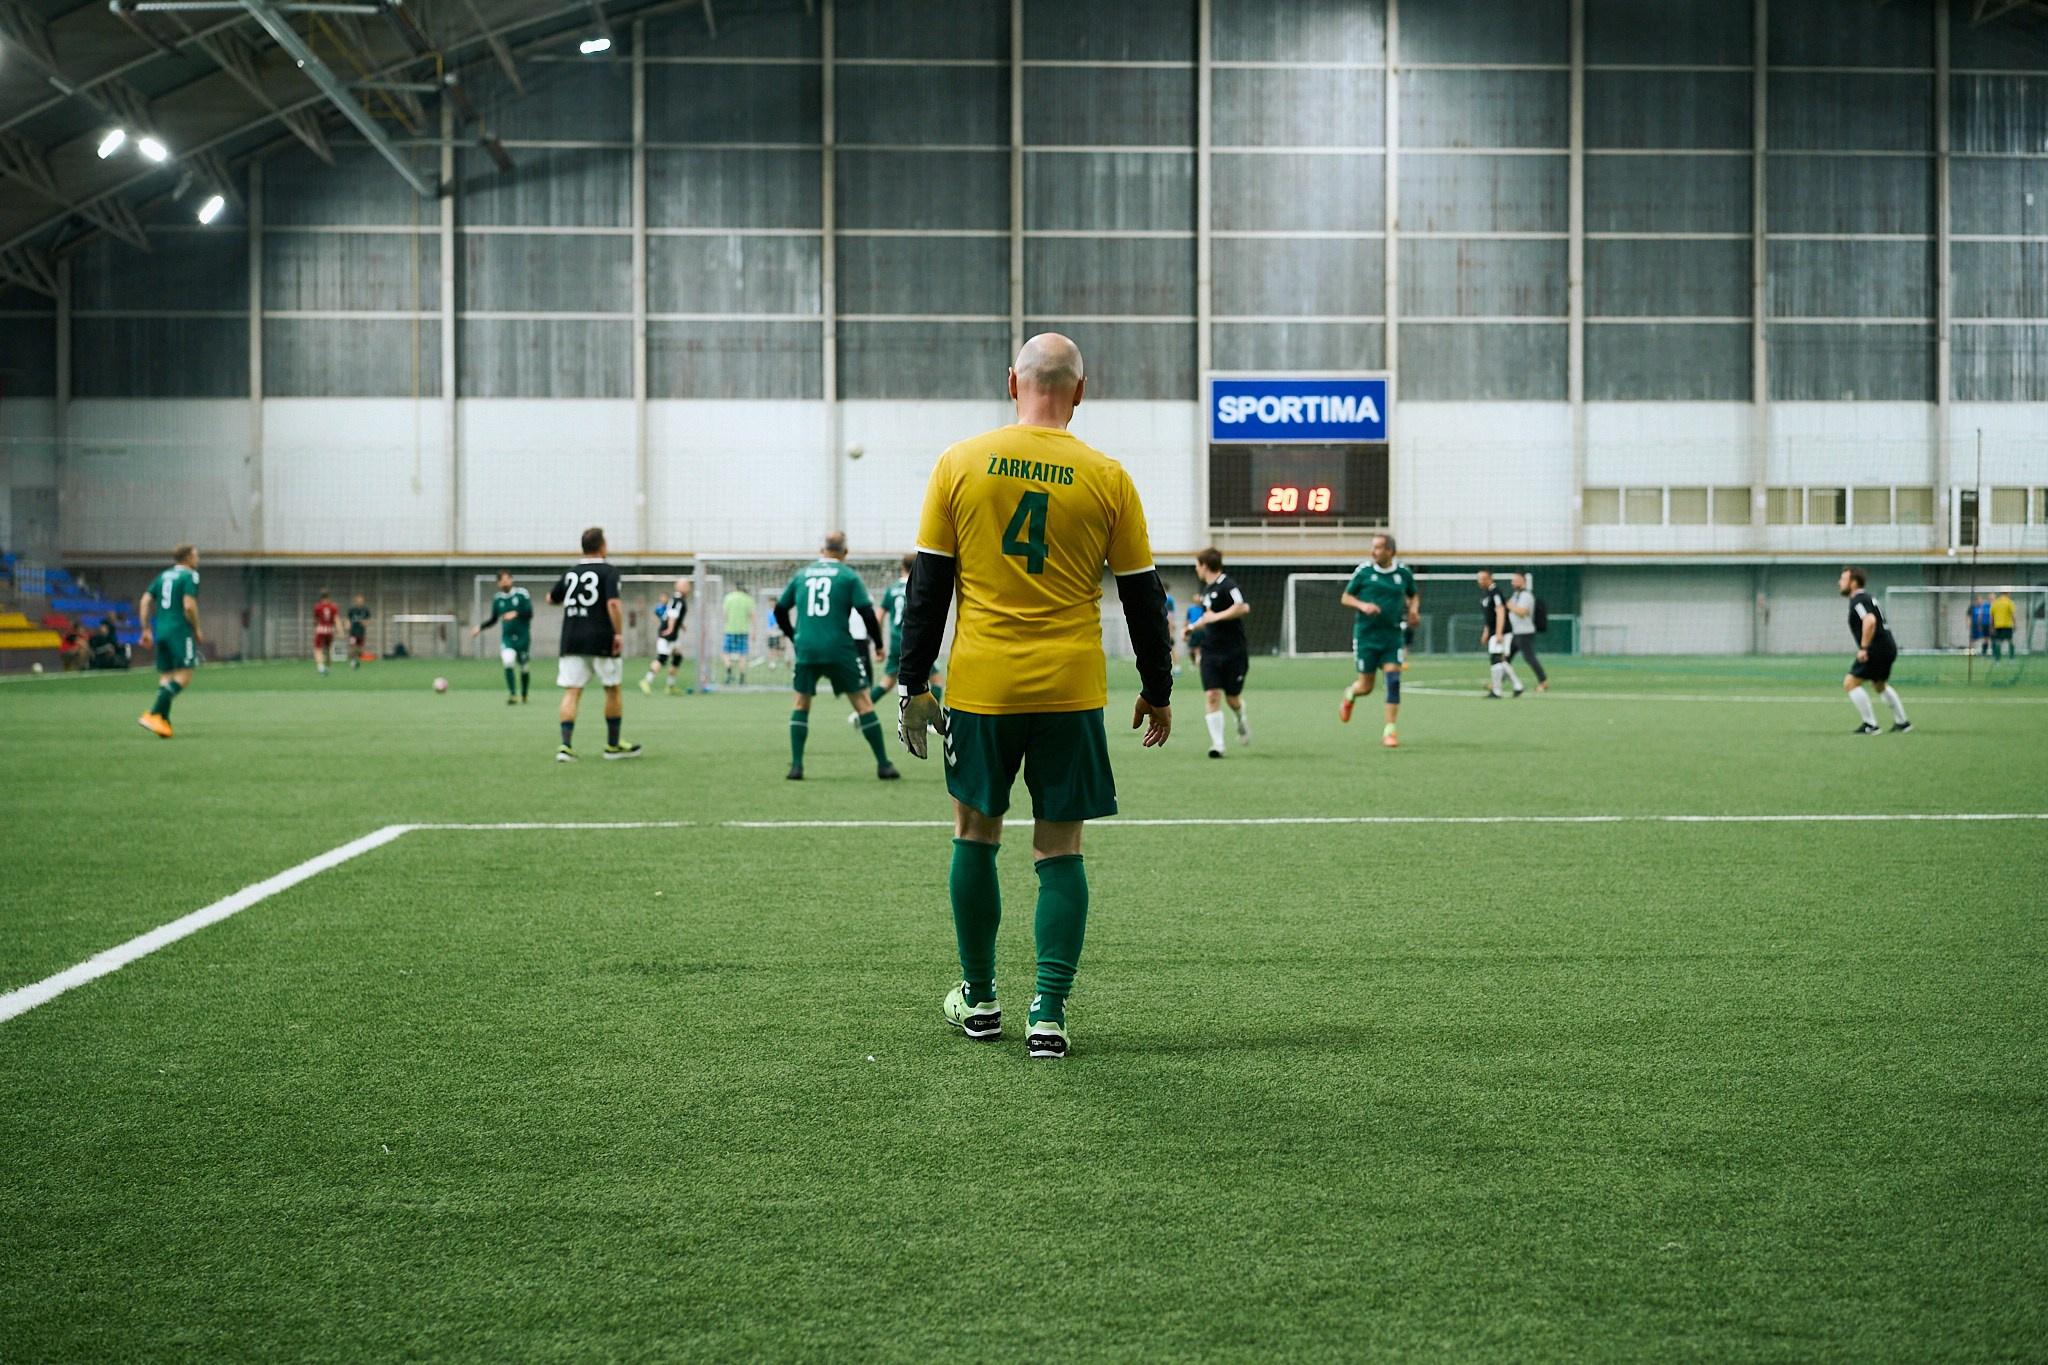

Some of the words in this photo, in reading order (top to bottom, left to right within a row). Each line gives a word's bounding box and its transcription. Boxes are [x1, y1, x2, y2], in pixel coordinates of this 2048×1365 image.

[1218, 395, 1380, 424] SPORTIMA
[987, 453, 1075, 485] ŽARKAITIS
[1267, 487, 1299, 512] 20
[1307, 487, 1331, 512] 13
[1002, 490, 1049, 574] 4
[563, 570, 599, 607] 23
[805, 576, 832, 617] 13
